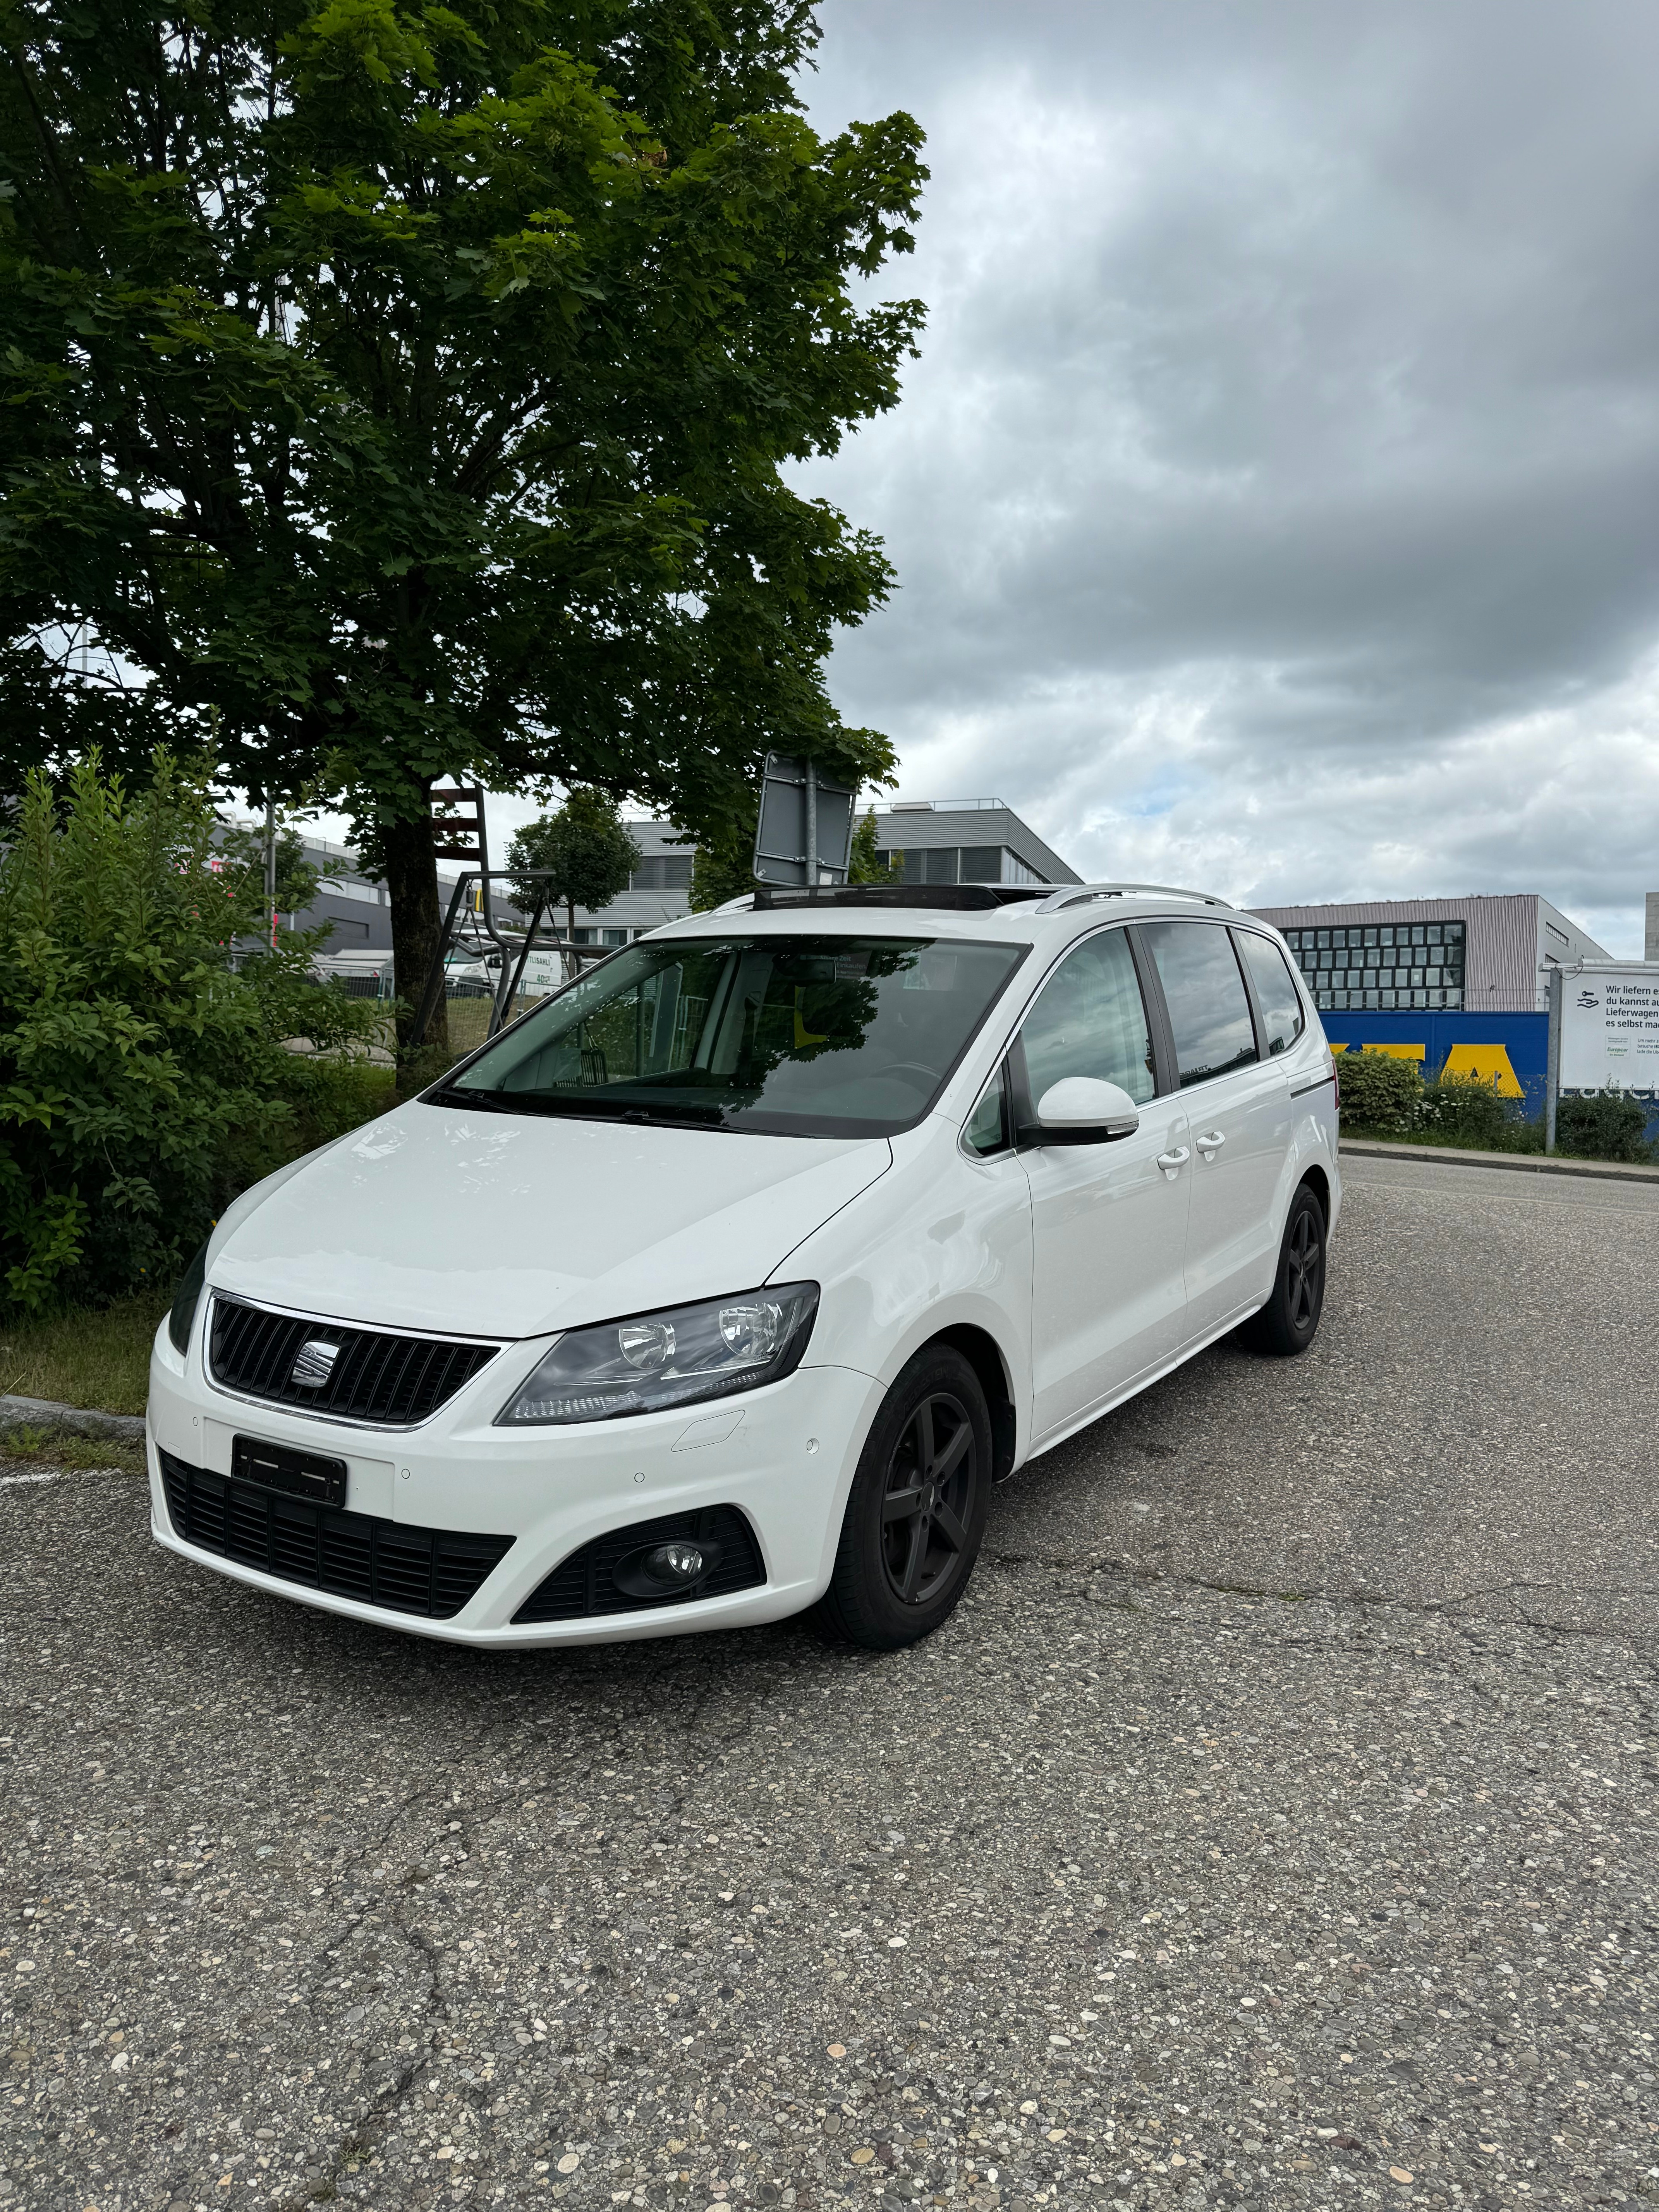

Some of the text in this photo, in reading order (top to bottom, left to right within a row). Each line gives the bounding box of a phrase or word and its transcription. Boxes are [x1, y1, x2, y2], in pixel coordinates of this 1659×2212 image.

[1606, 985, 1621, 994] Wir
[1623, 986, 1650, 995] liefern
[1606, 996, 1617, 1005] du
[1620, 997, 1649, 1006] kannst
[1606, 1008, 1658, 1019] Lieferwagen
[1617, 1019, 1643, 1028] selbst
